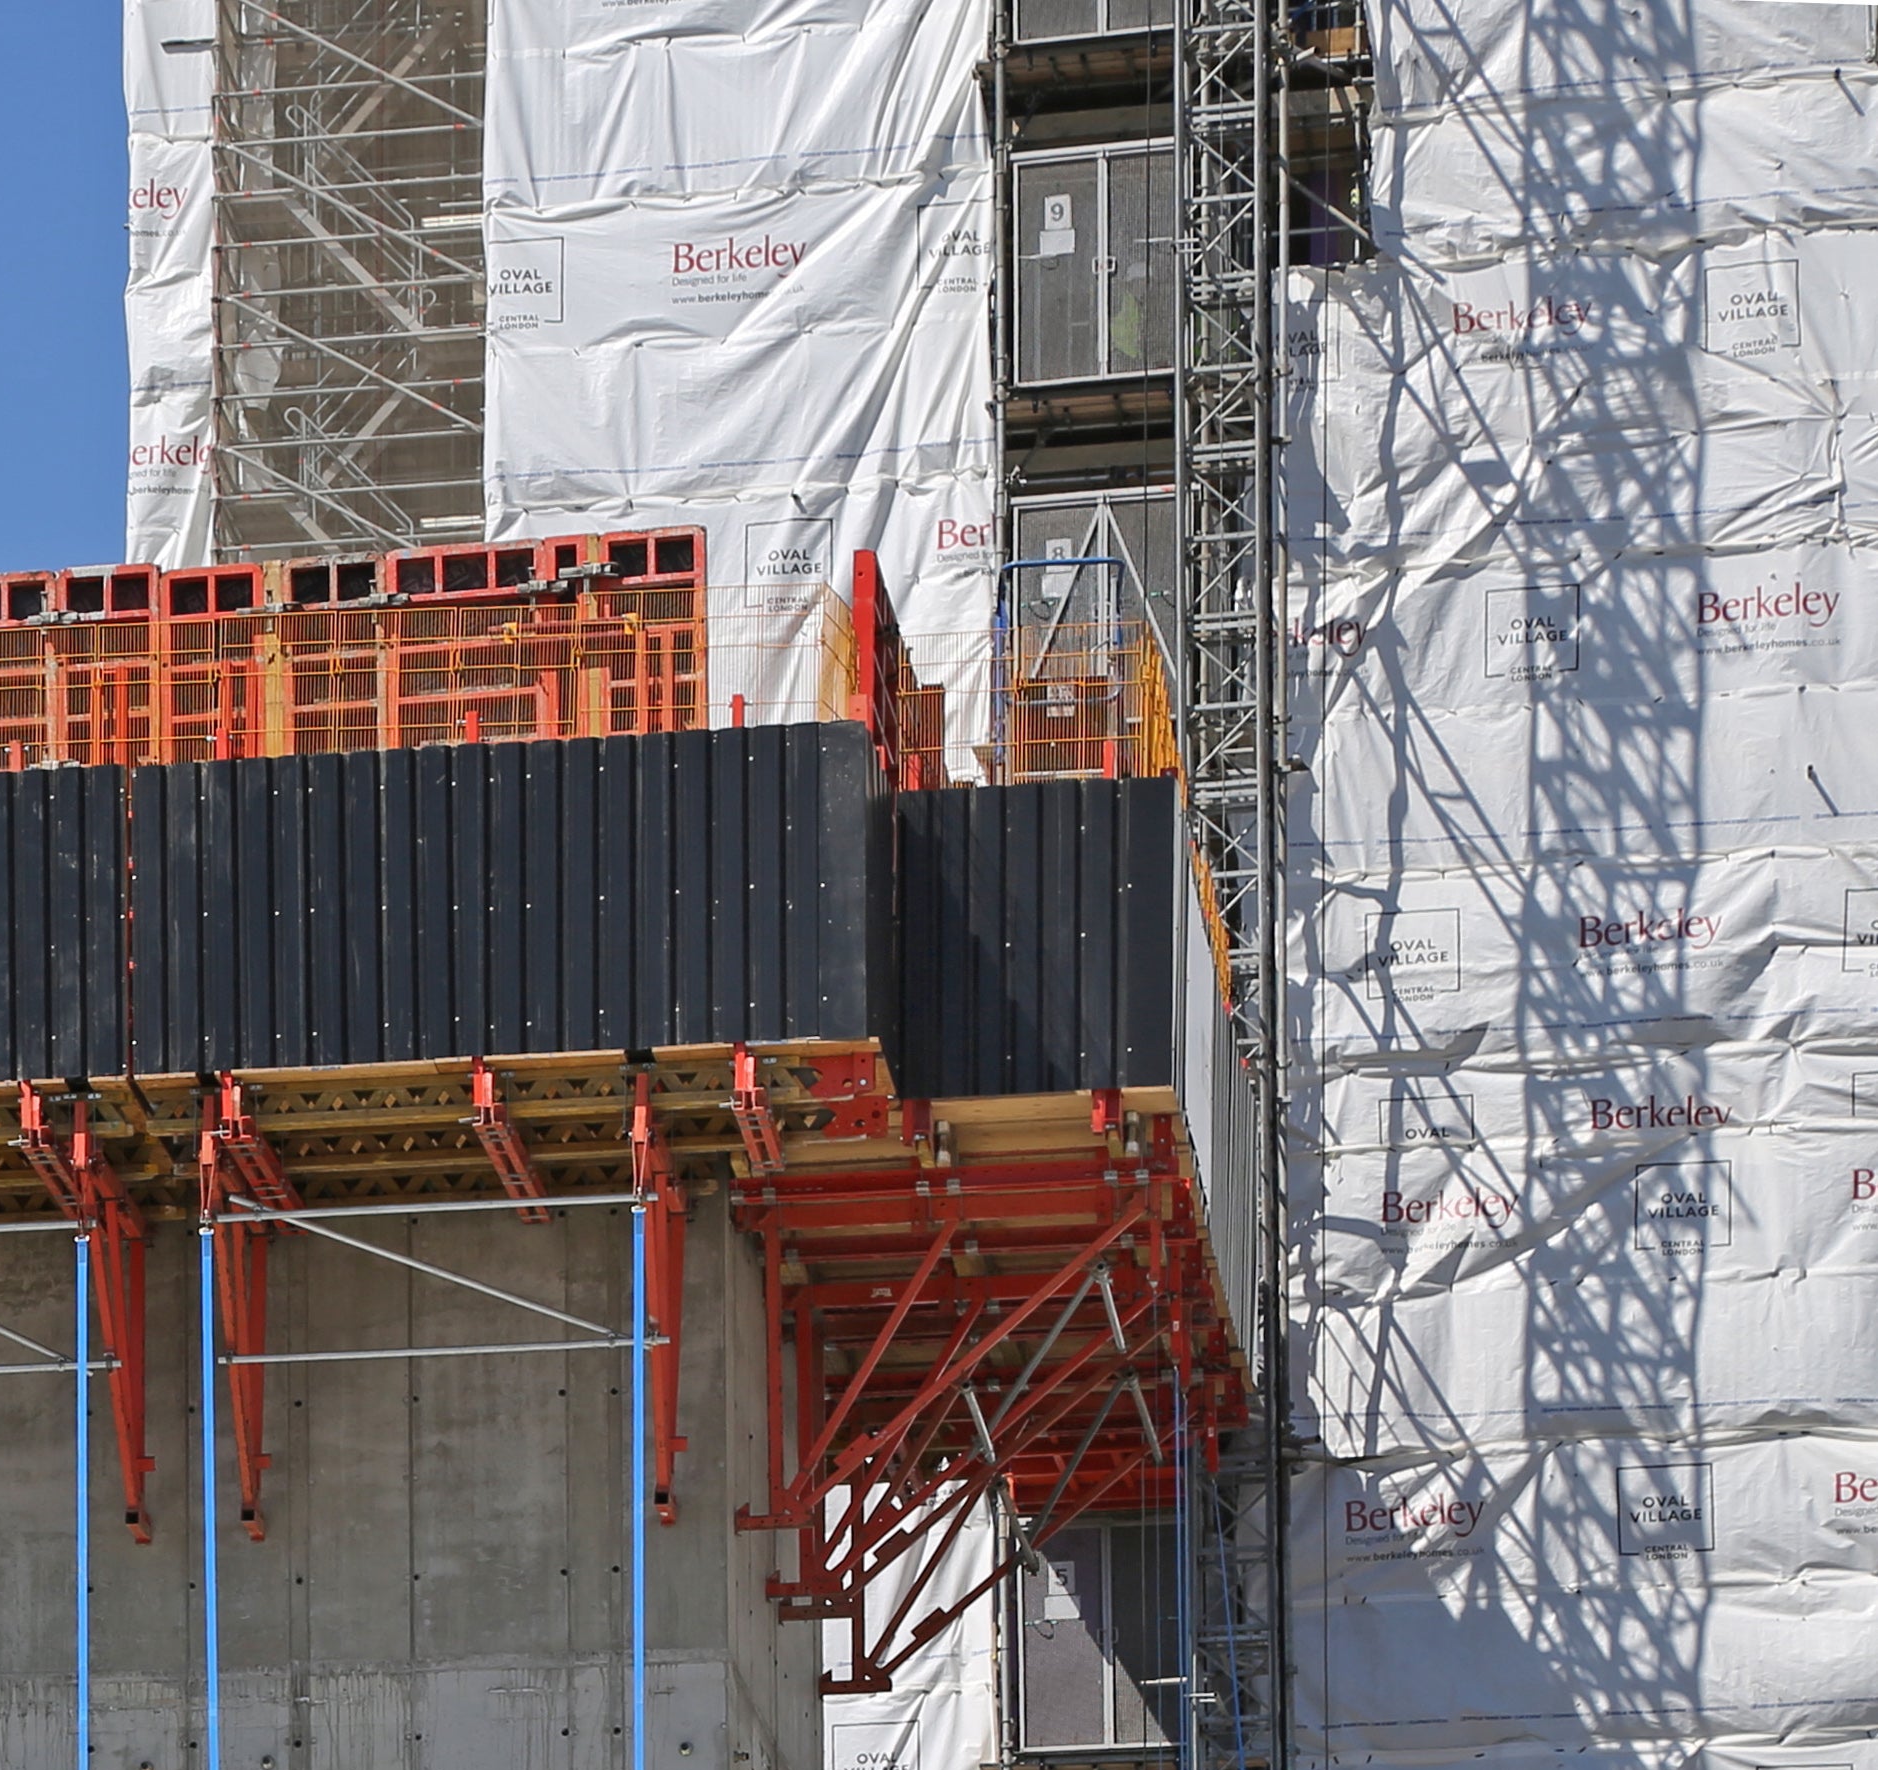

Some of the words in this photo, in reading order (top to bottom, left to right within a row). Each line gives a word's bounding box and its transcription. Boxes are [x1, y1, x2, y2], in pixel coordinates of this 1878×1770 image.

[1050, 203, 1064, 222] 9
[672, 234, 806, 279] Berkeley
[499, 268, 542, 281] OVAL
[671, 275, 715, 287] Designed
[716, 273, 730, 284] for
[731, 272, 748, 283] life
[487, 281, 553, 295] VILLAGE
[1730, 290, 1779, 306] OVAL
[499, 314, 540, 323] CENTRAL
[1452, 295, 1592, 335] Berkeley
[1718, 304, 1788, 322] VILLAGE
[499, 322, 540, 330] LONDON
[1732, 332, 1779, 350] CENTRAL
[1733, 346, 1776, 358] LONDON
[767, 549, 811, 562] OVAL
[756, 563, 823, 576] VILLAGE
[1697, 581, 1840, 628] Berkeley
[1510, 615, 1555, 630] OVAL
[1497, 629, 1567, 646] VILLAGE
[1509, 665, 1553, 675] CENTRAL
[1510, 673, 1553, 682] LONDON
[1579, 907, 1722, 950] Berkeley
[1390, 938, 1437, 952] OVAL
[1378, 951, 1449, 967] VILLAGE
[1405, 1127, 1451, 1140] OVAL
[1661, 1191, 1707, 1205] OVAL
[1381, 1187, 1520, 1229] Berkeley
[1647, 1204, 1720, 1219] VILLAGE
[1661, 1239, 1705, 1249] CENTRAL
[1661, 1248, 1704, 1257] LONDON
[1642, 1495, 1690, 1509] OVAL
[1345, 1492, 1486, 1538] Berkeley
[1630, 1508, 1703, 1524] VILLAGE
[1345, 1532, 1390, 1546] Designed
[1644, 1543, 1690, 1553] CENTRAL
[1645, 1551, 1690, 1561] LONDON
[856, 1752, 897, 1765] OVAL
